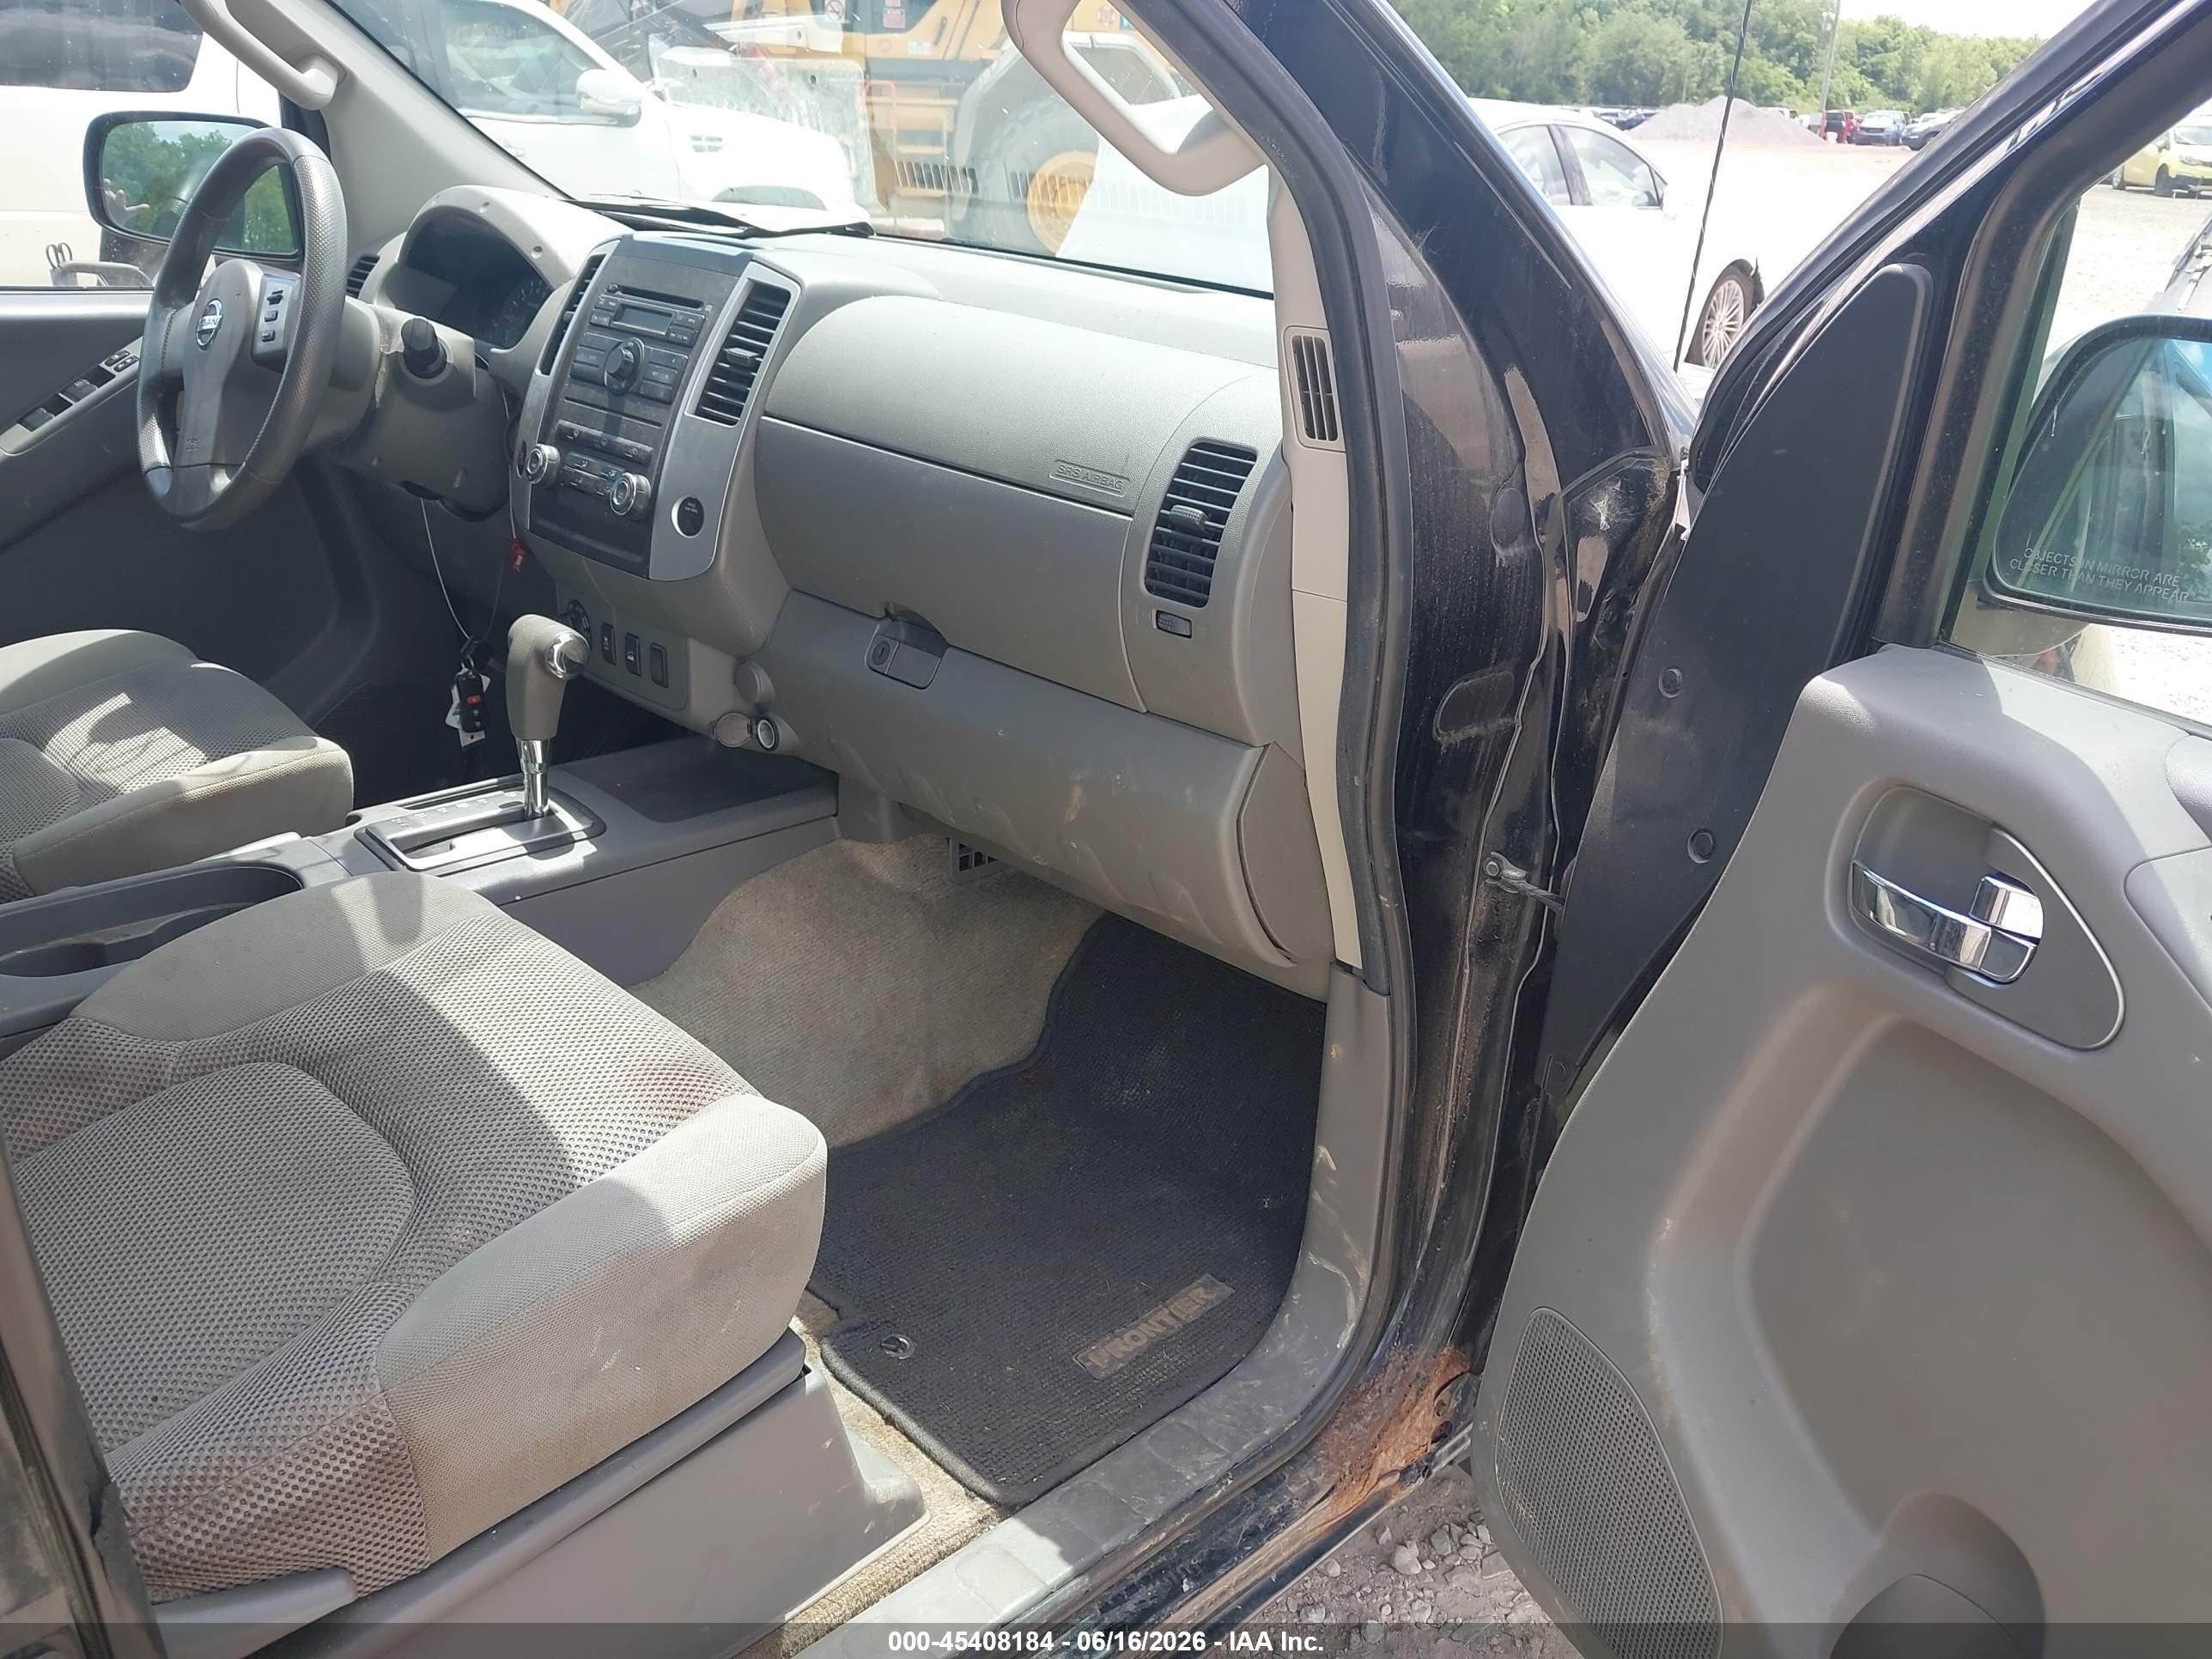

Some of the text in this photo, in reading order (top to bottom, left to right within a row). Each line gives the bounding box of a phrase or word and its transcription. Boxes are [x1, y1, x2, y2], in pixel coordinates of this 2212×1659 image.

[1056, 465, 1124, 490] SRS AIRBAG
[2009, 558, 2190, 602] CLOSER THAN THEY APPEAR
[2024, 548, 2181, 586] OBJECTS IN MIRROR ARE
